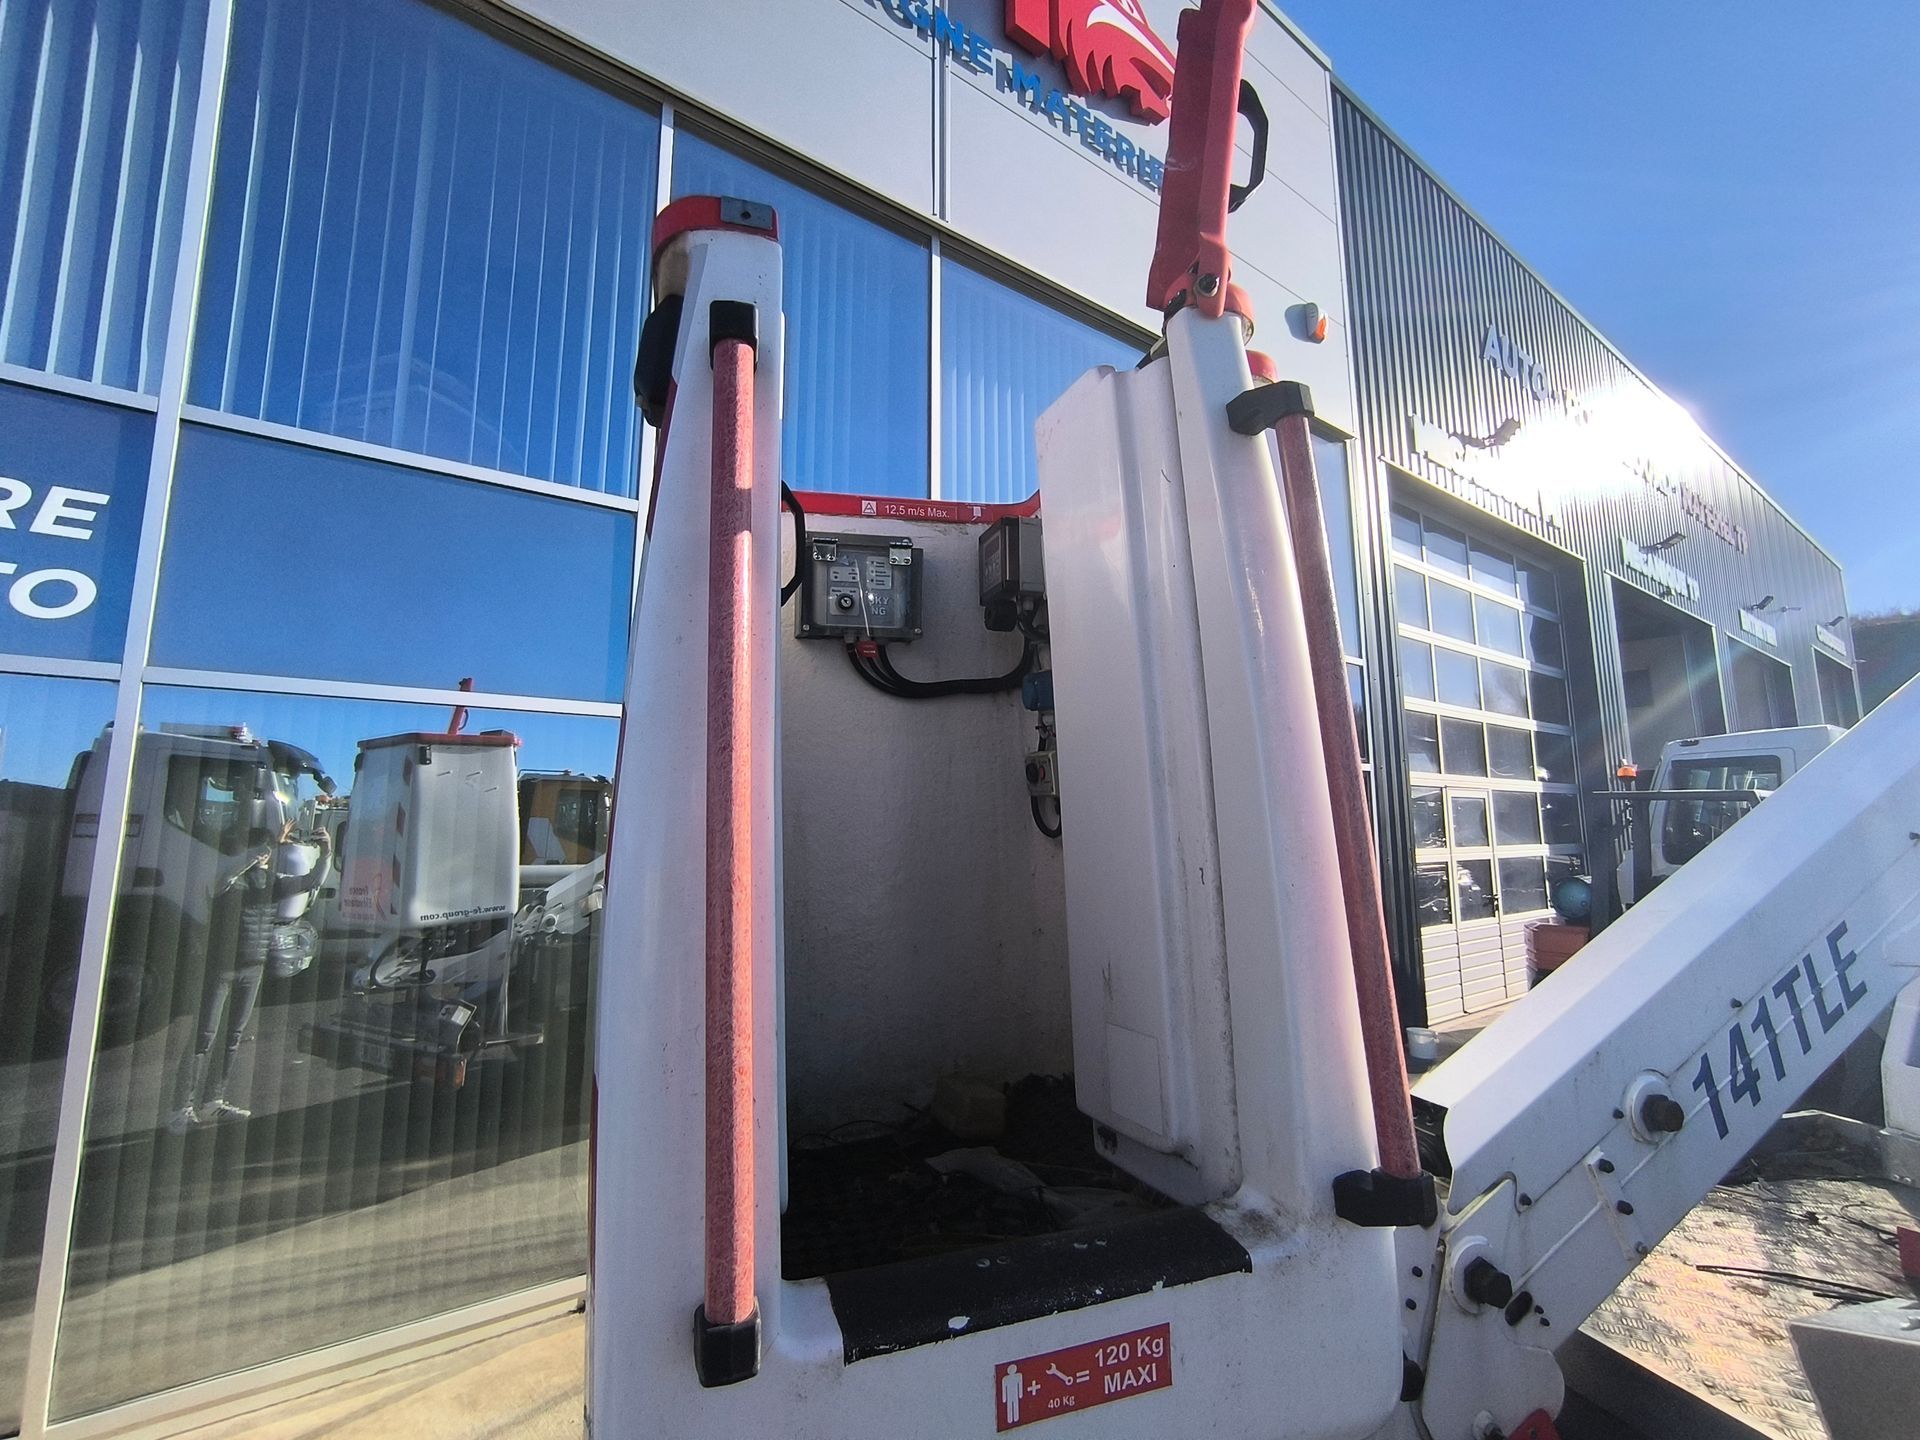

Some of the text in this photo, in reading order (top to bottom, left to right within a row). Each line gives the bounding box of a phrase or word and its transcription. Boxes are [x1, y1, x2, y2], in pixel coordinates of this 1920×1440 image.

[1481, 324, 1549, 401] AUTO
[884, 505, 950, 518] 12,5 m/s Max.
[0, 561, 97, 619] O
[1692, 919, 1868, 1140] 141TLE
[1095, 1336, 1164, 1368] 120 Kg
[1104, 1362, 1157, 1394] MAXI
[1047, 1395, 1076, 1409] 40 Kg
